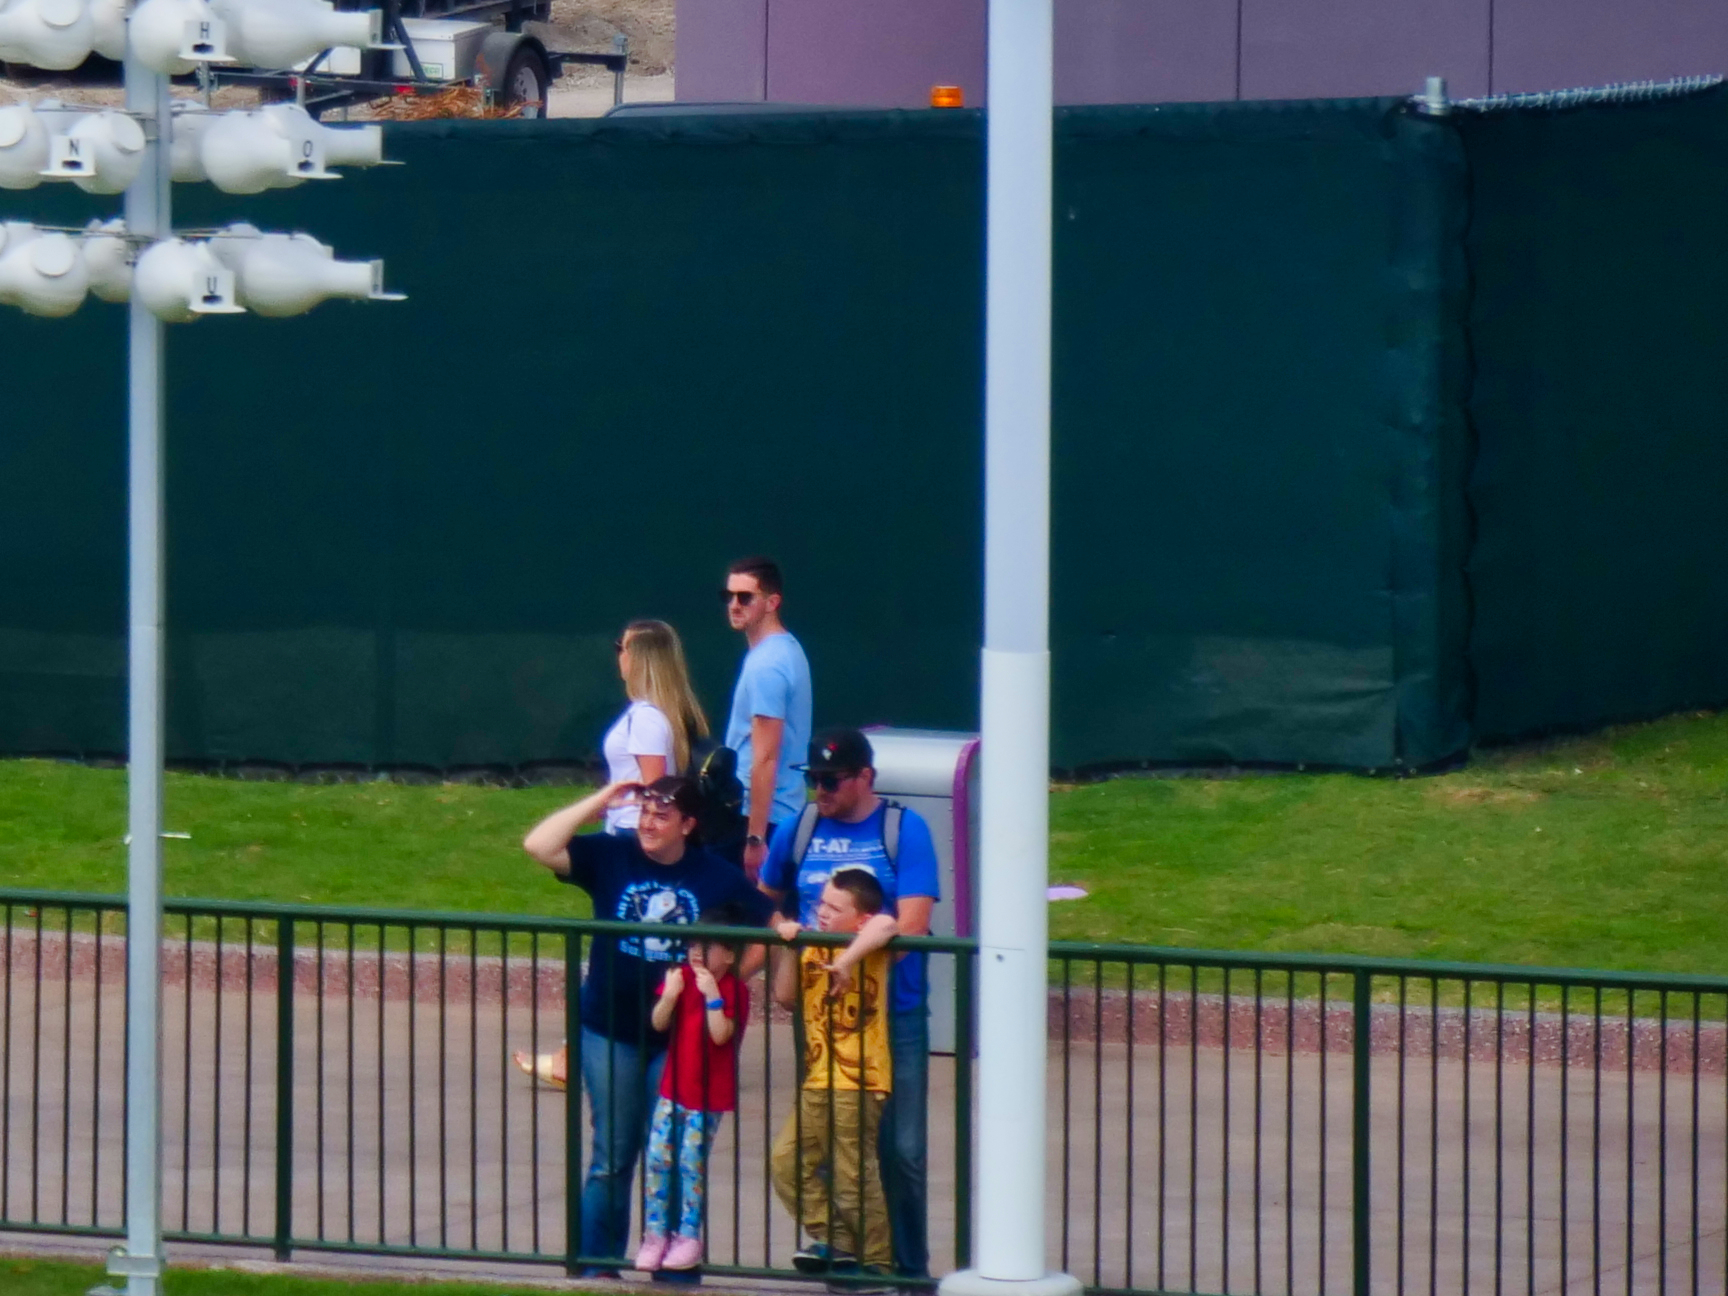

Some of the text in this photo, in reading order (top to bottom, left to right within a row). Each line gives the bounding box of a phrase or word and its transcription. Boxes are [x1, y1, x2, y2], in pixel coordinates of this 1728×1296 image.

[200, 21, 209, 40] H
[69, 138, 79, 156] N
[207, 276, 217, 295] U
[808, 838, 852, 854] T-AT
